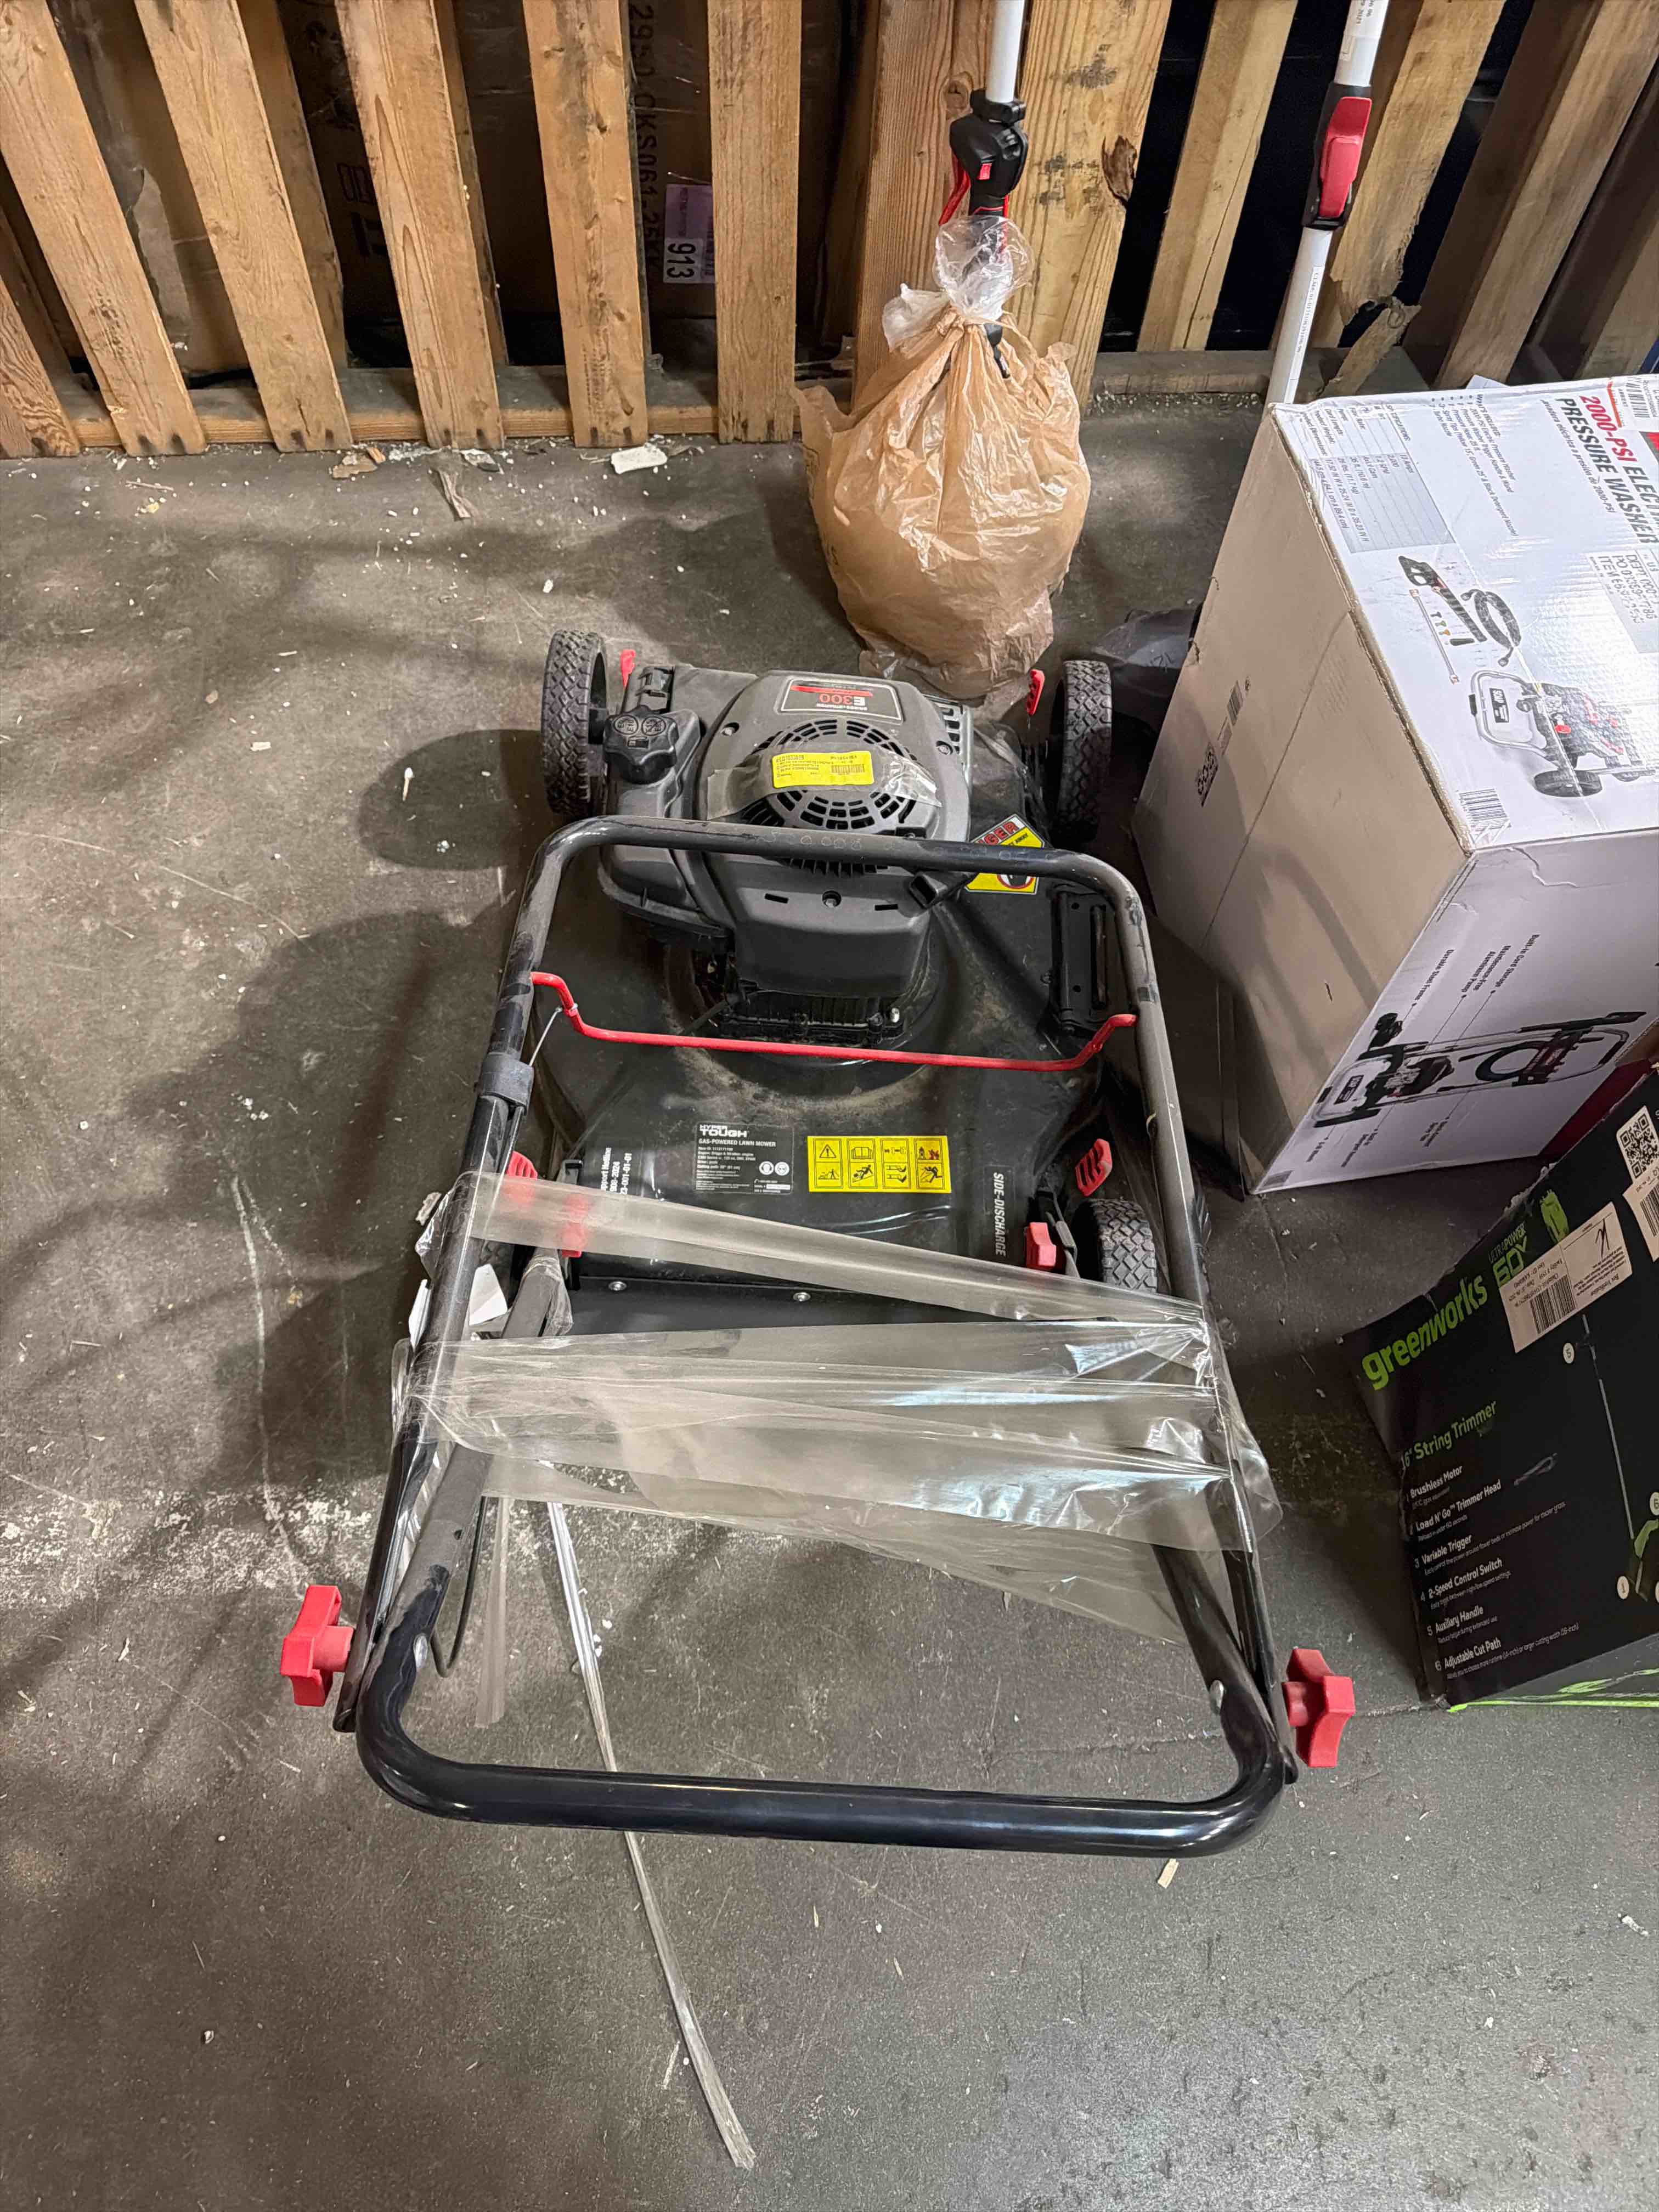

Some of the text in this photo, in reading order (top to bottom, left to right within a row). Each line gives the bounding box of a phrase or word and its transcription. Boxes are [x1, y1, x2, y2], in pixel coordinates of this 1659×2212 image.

[667, 244, 696, 279] 913
[1579, 394, 1638, 463] 2000-PSI
[1402, 461, 1415, 473] Amps
[1540, 399, 1561, 422] avadora
[1572, 454, 1594, 476] presión
[1592, 486, 1616, 513] 2000-PSI
[1559, 397, 1618, 473] PRESSURE
[1602, 477, 1659, 544] WASHER
[1482, 482, 1497, 495] Black
[1488, 495, 1510, 518] Detergent
[819, 693, 865, 706] E300
[1492, 689, 1505, 704] SOAP
[1460, 950, 1496, 993] Aluminum Pump
[1493, 967, 1514, 988] Storage
[1414, 983, 1430, 1001] Frame
[699, 1128, 747, 1137] TOUGH
[601, 1147, 611, 1169] Hotline
[990, 1172, 1008, 1256] SIDE-DISCHARGE
[1362, 1274, 1487, 1390] greenworks
[1414, 1429, 1452, 1460] String
[1451, 1401, 1497, 1443] Trimmer
[1410, 1475, 1444, 1499] Brushless
[1443, 1465, 1463, 1482] Motor
[1415, 1516, 1434, 1532] Load
[1457, 1490, 1484, 1512] Trimmer
[1483, 1479, 1502, 1496] Head
[1414, 1533, 1473, 1568] 3 Variable Trigger
[1427, 1578, 1454, 1600] 2-Speed
[1453, 1567, 1479, 1586] Control
[1479, 1556, 1503, 1576] Switch
[1426, 1604, 1483, 1637] 5 Auxiliary Handle
[1435, 1638, 1501, 1671] 6 Adjustable Cut Path
